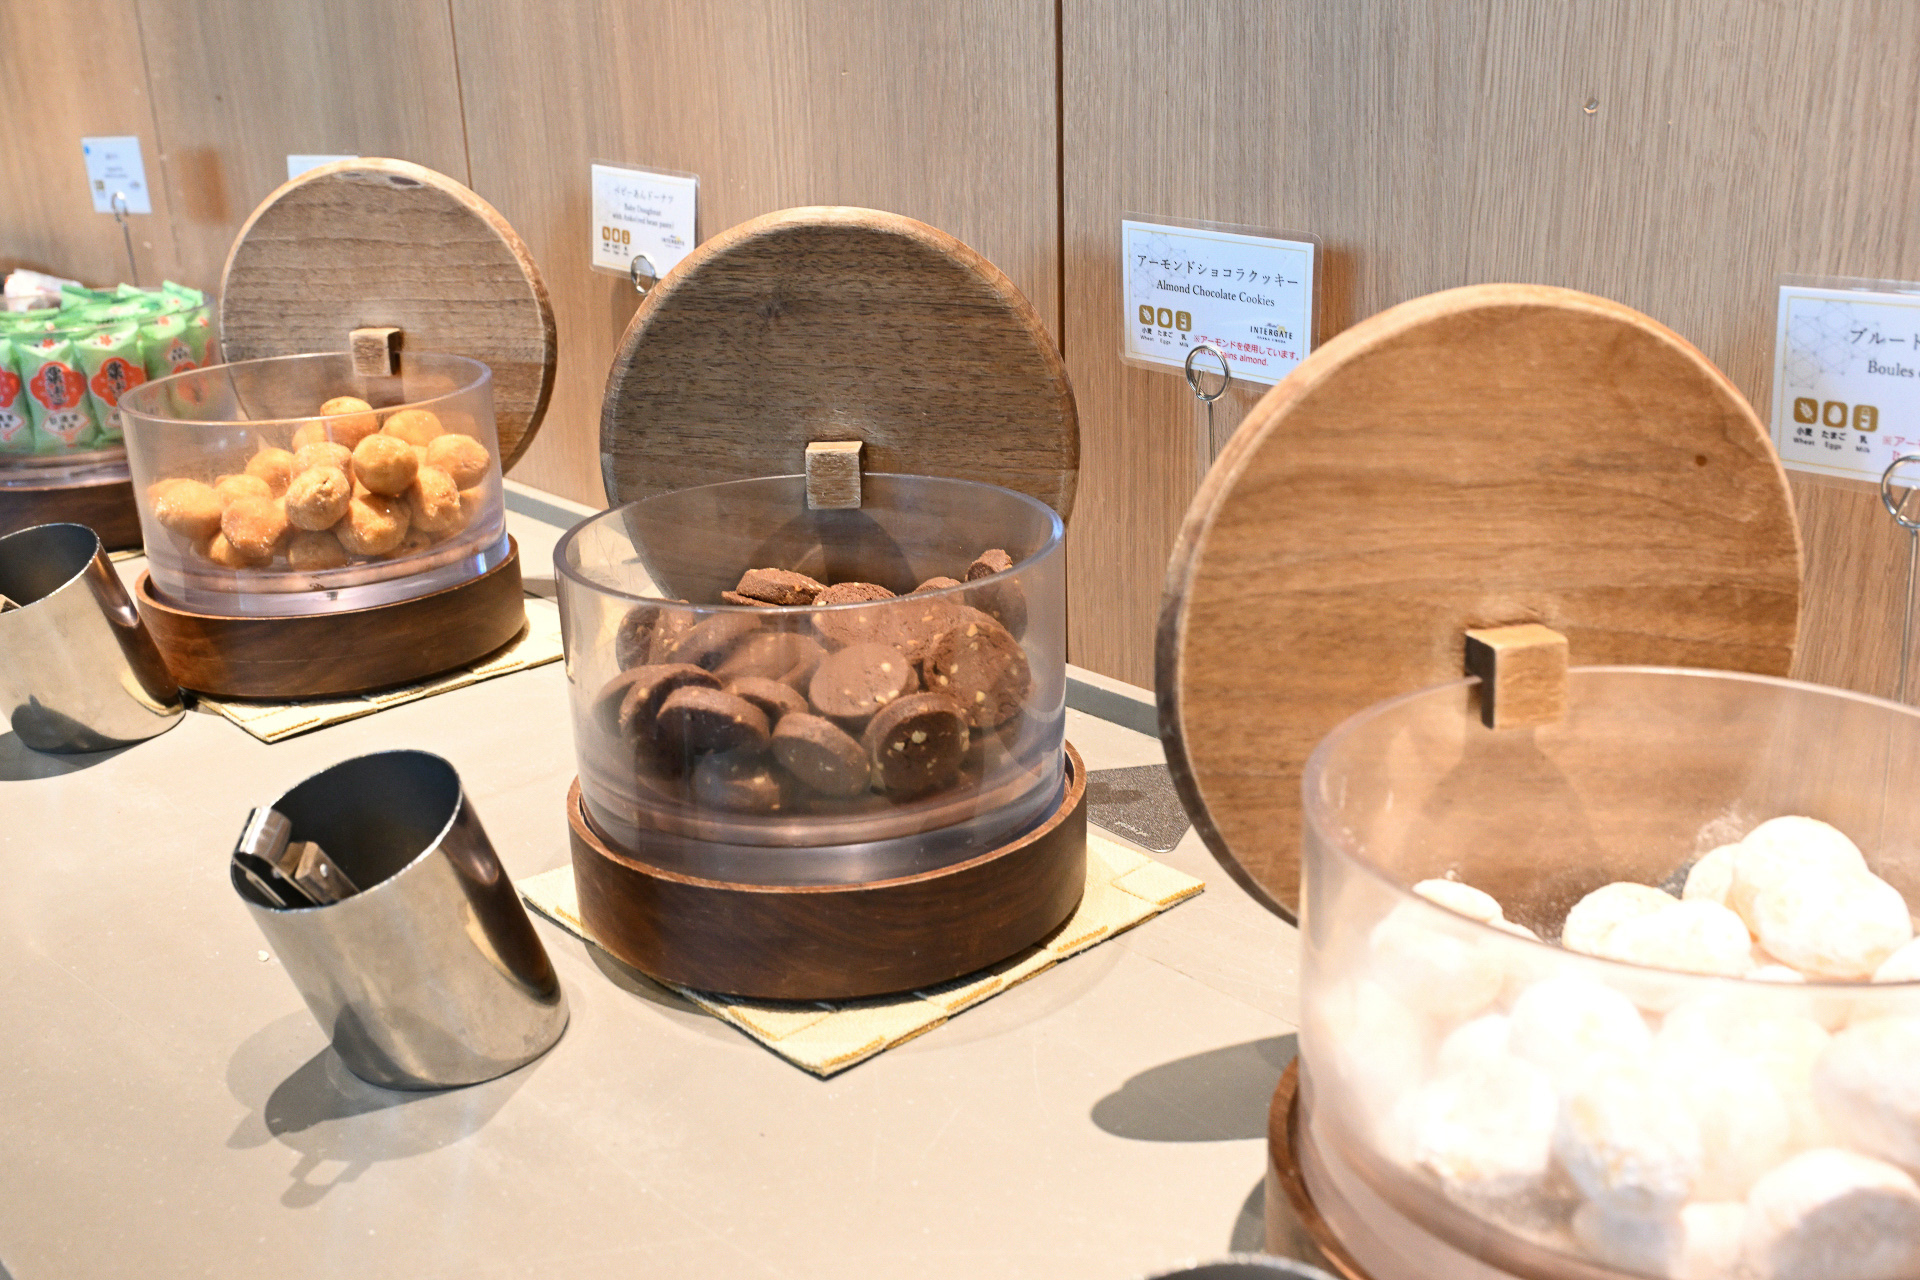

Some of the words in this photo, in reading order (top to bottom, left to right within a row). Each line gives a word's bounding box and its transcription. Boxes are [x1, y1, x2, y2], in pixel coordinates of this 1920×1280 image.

[1137, 254, 1299, 287] アーモンドショコラクッキー
[1156, 279, 1191, 294] Almond
[1192, 284, 1237, 301] Chocolate
[1239, 292, 1275, 307] Cookies
[1250, 325, 1293, 340] INTERGATE
[1240, 354, 1268, 367] almond.
[1868, 360, 1914, 378] Boules
[1797, 427, 1813, 437] 小麦
[1821, 430, 1846, 441] たまご
[1793, 437, 1815, 446] Wheat
[1825, 441, 1842, 450] Eggs
[1855, 445, 1870, 453] Milk
